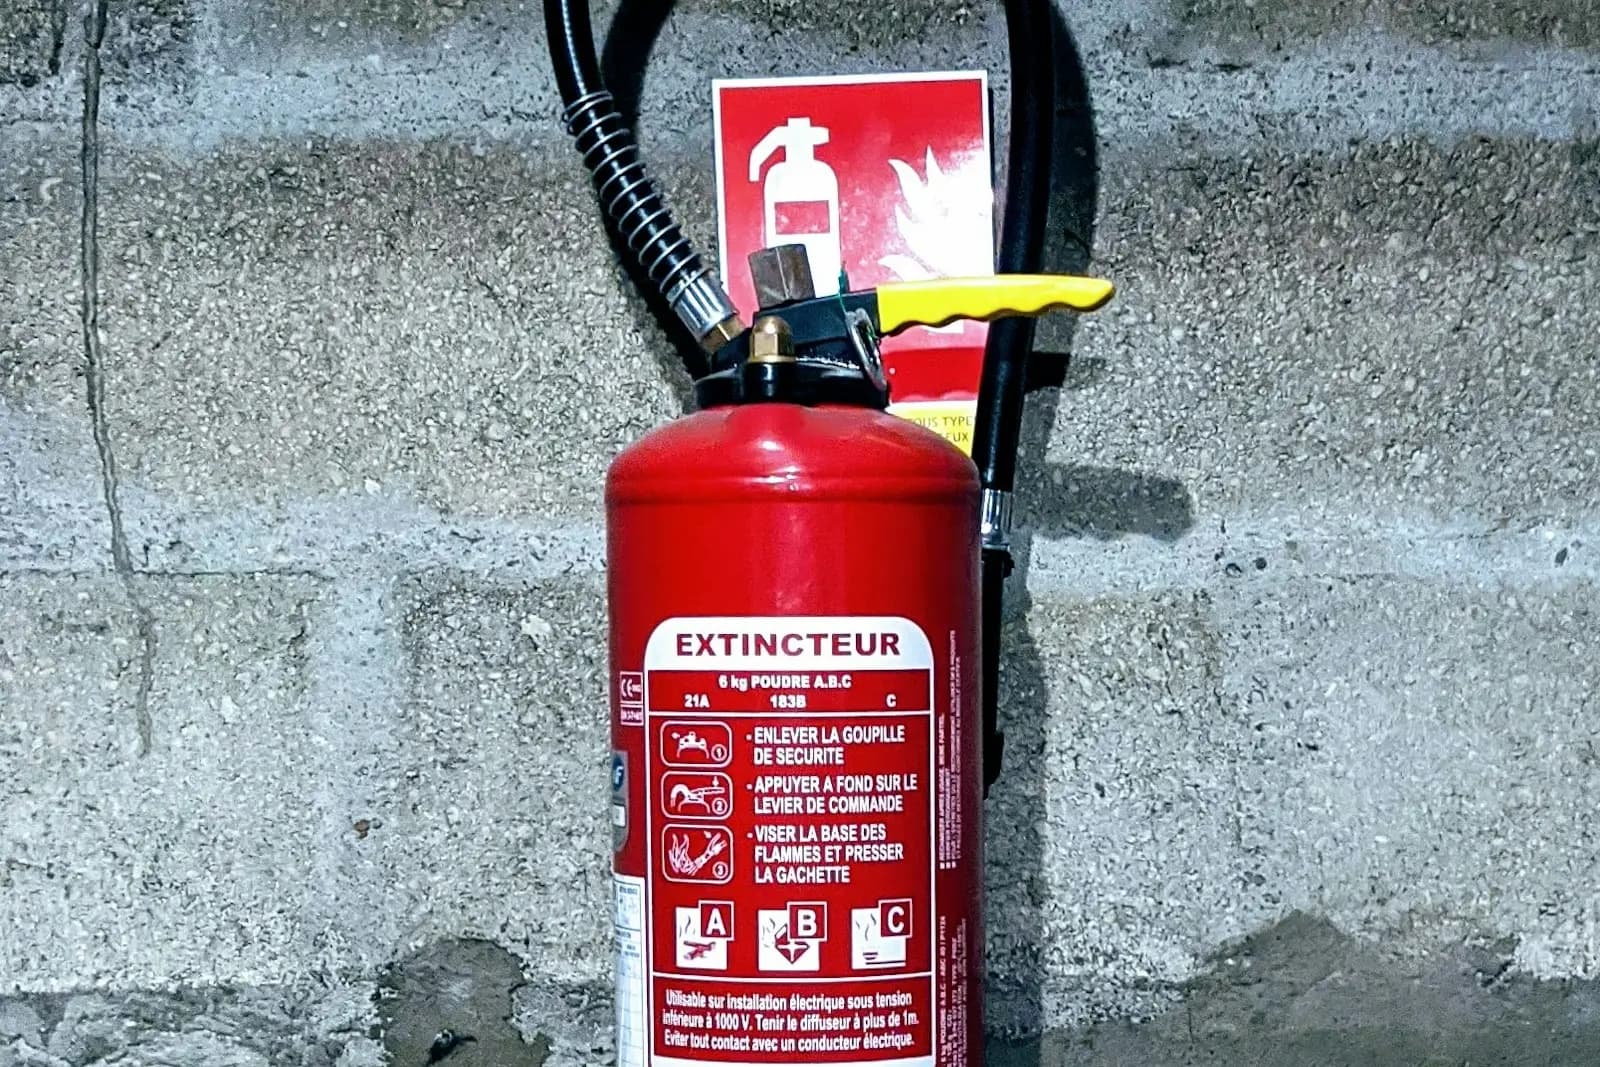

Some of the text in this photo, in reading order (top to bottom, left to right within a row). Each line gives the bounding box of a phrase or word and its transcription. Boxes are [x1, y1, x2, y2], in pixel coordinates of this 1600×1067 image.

[677, 633, 900, 656] EXTINCTEUR
[719, 676, 851, 691] 6 kg POUDRE A.B.C
[685, 695, 896, 707] 21A 183B C
[755, 726, 904, 744] ENLEVER LA GOUPILLE
[716, 747, 721, 757] 1
[754, 748, 843, 765] DE SECURITE
[755, 775, 917, 792] APPUYER A FOND SUR LE
[716, 801, 723, 811] 2
[755, 796, 902, 814] LEVIER DE COMMANDE
[756, 824, 886, 842] VISER LA BASE DES
[756, 843, 903, 862] FLAMMES ET PRESSER
[717, 865, 724, 876] 3
[755, 865, 849, 883] LA GACHETTE
[706, 909, 725, 934] A
[799, 909, 816, 934] B
[887, 906, 904, 931] C
[666, 989, 912, 1012] Utilisable sur installation électrique sous tension
[663, 1009, 918, 1031] inférieure à 1000 V. Tenir le diffuseur à plus de 1m.
[665, 1031, 914, 1051] Eviter tout contact avec un conducteur électrique.
